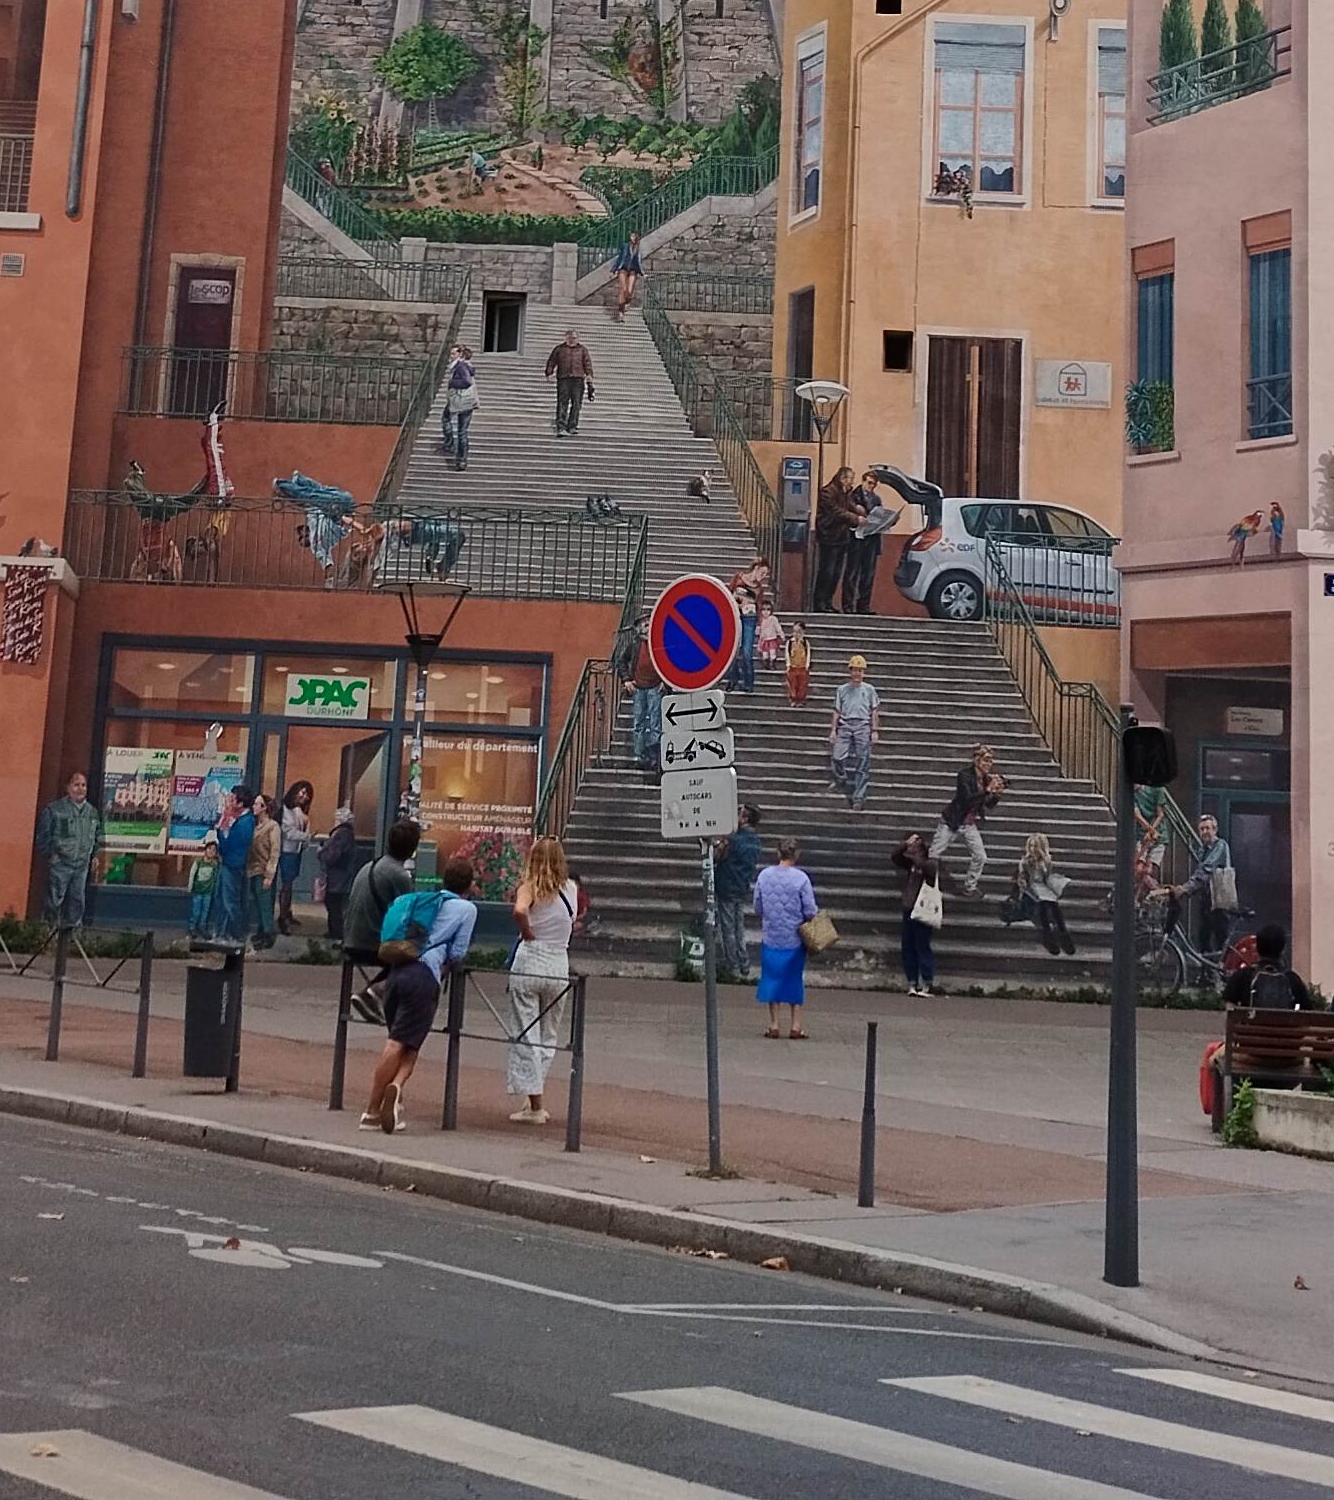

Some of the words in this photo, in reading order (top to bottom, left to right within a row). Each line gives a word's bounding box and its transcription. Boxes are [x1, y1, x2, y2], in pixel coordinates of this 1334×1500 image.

[457, 740, 471, 751] du
[473, 740, 538, 753] département
[689, 778, 703, 787] SAUF
[681, 791, 713, 801] AUTOCARS
[457, 802, 489, 812] SERVICE
